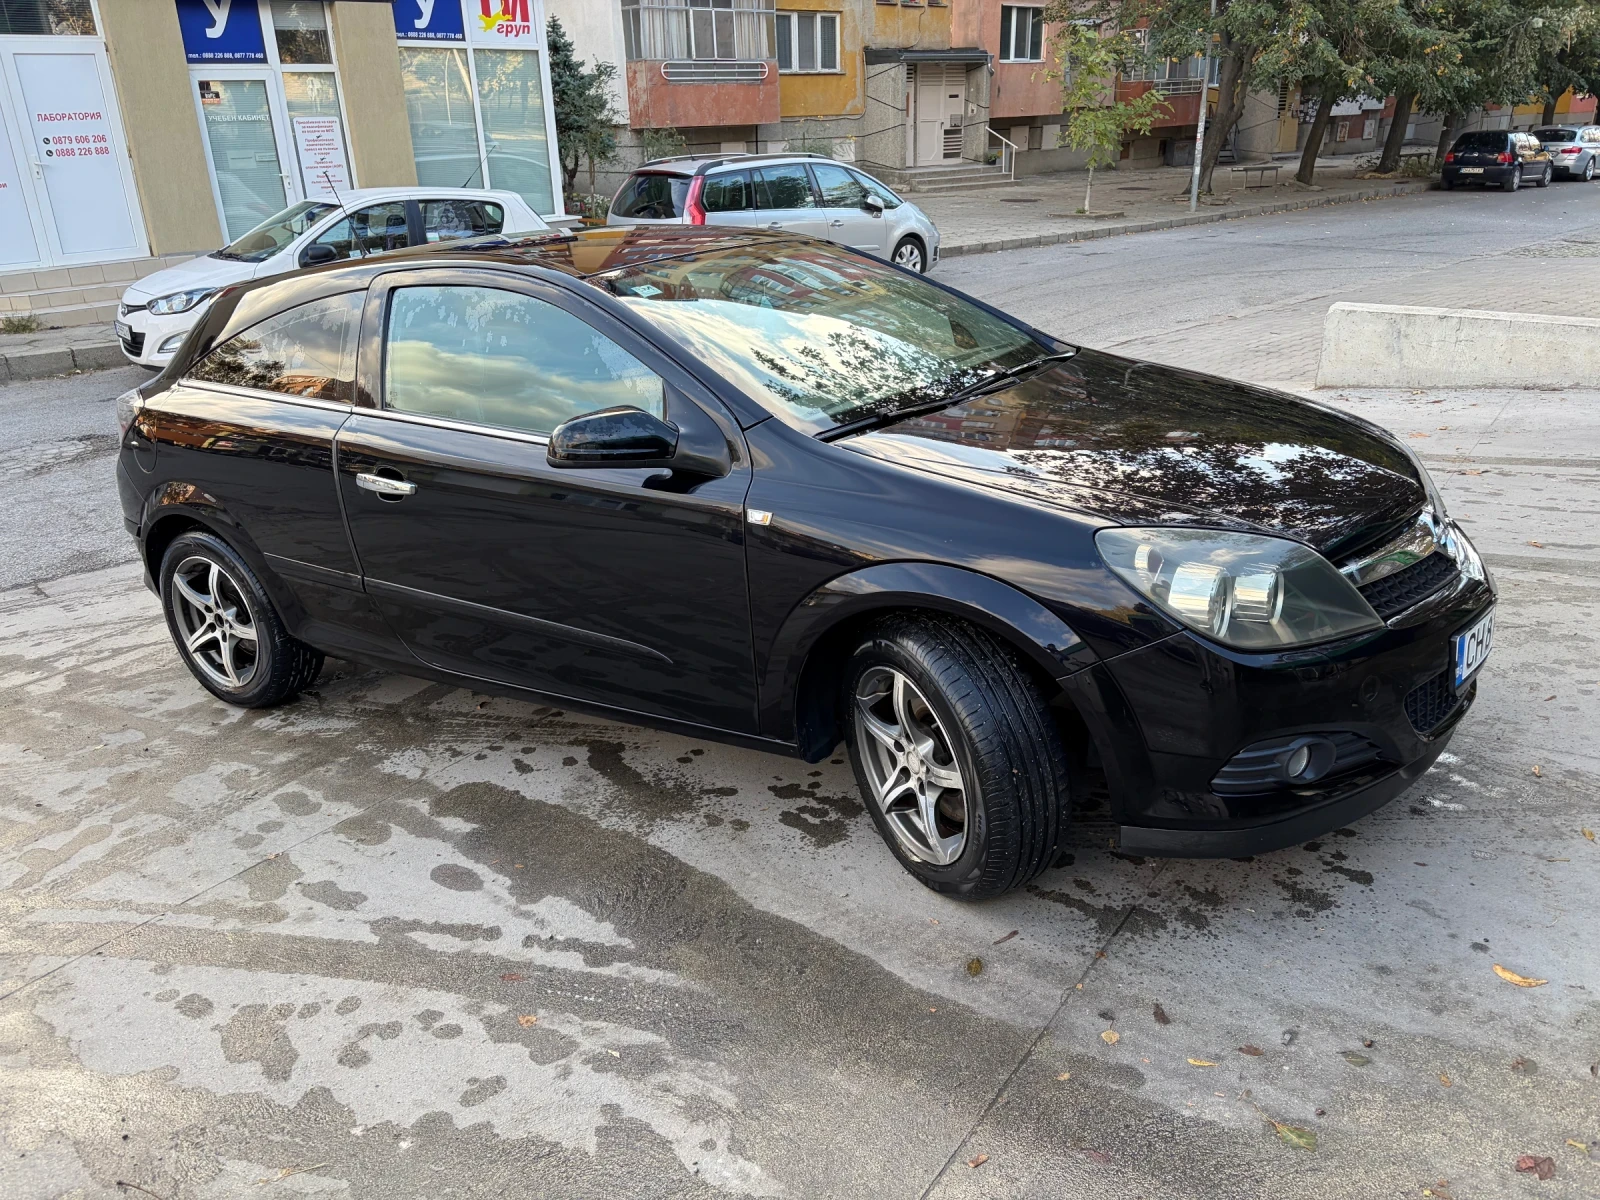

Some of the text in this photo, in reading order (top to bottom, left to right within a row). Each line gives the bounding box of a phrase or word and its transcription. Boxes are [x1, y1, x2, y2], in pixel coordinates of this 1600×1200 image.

[36, 112, 102, 122] ЛАБОРАТОРИЯ
[52, 134, 107, 145] 0879 606 206
[55, 146, 110, 157] 0888 226 888
